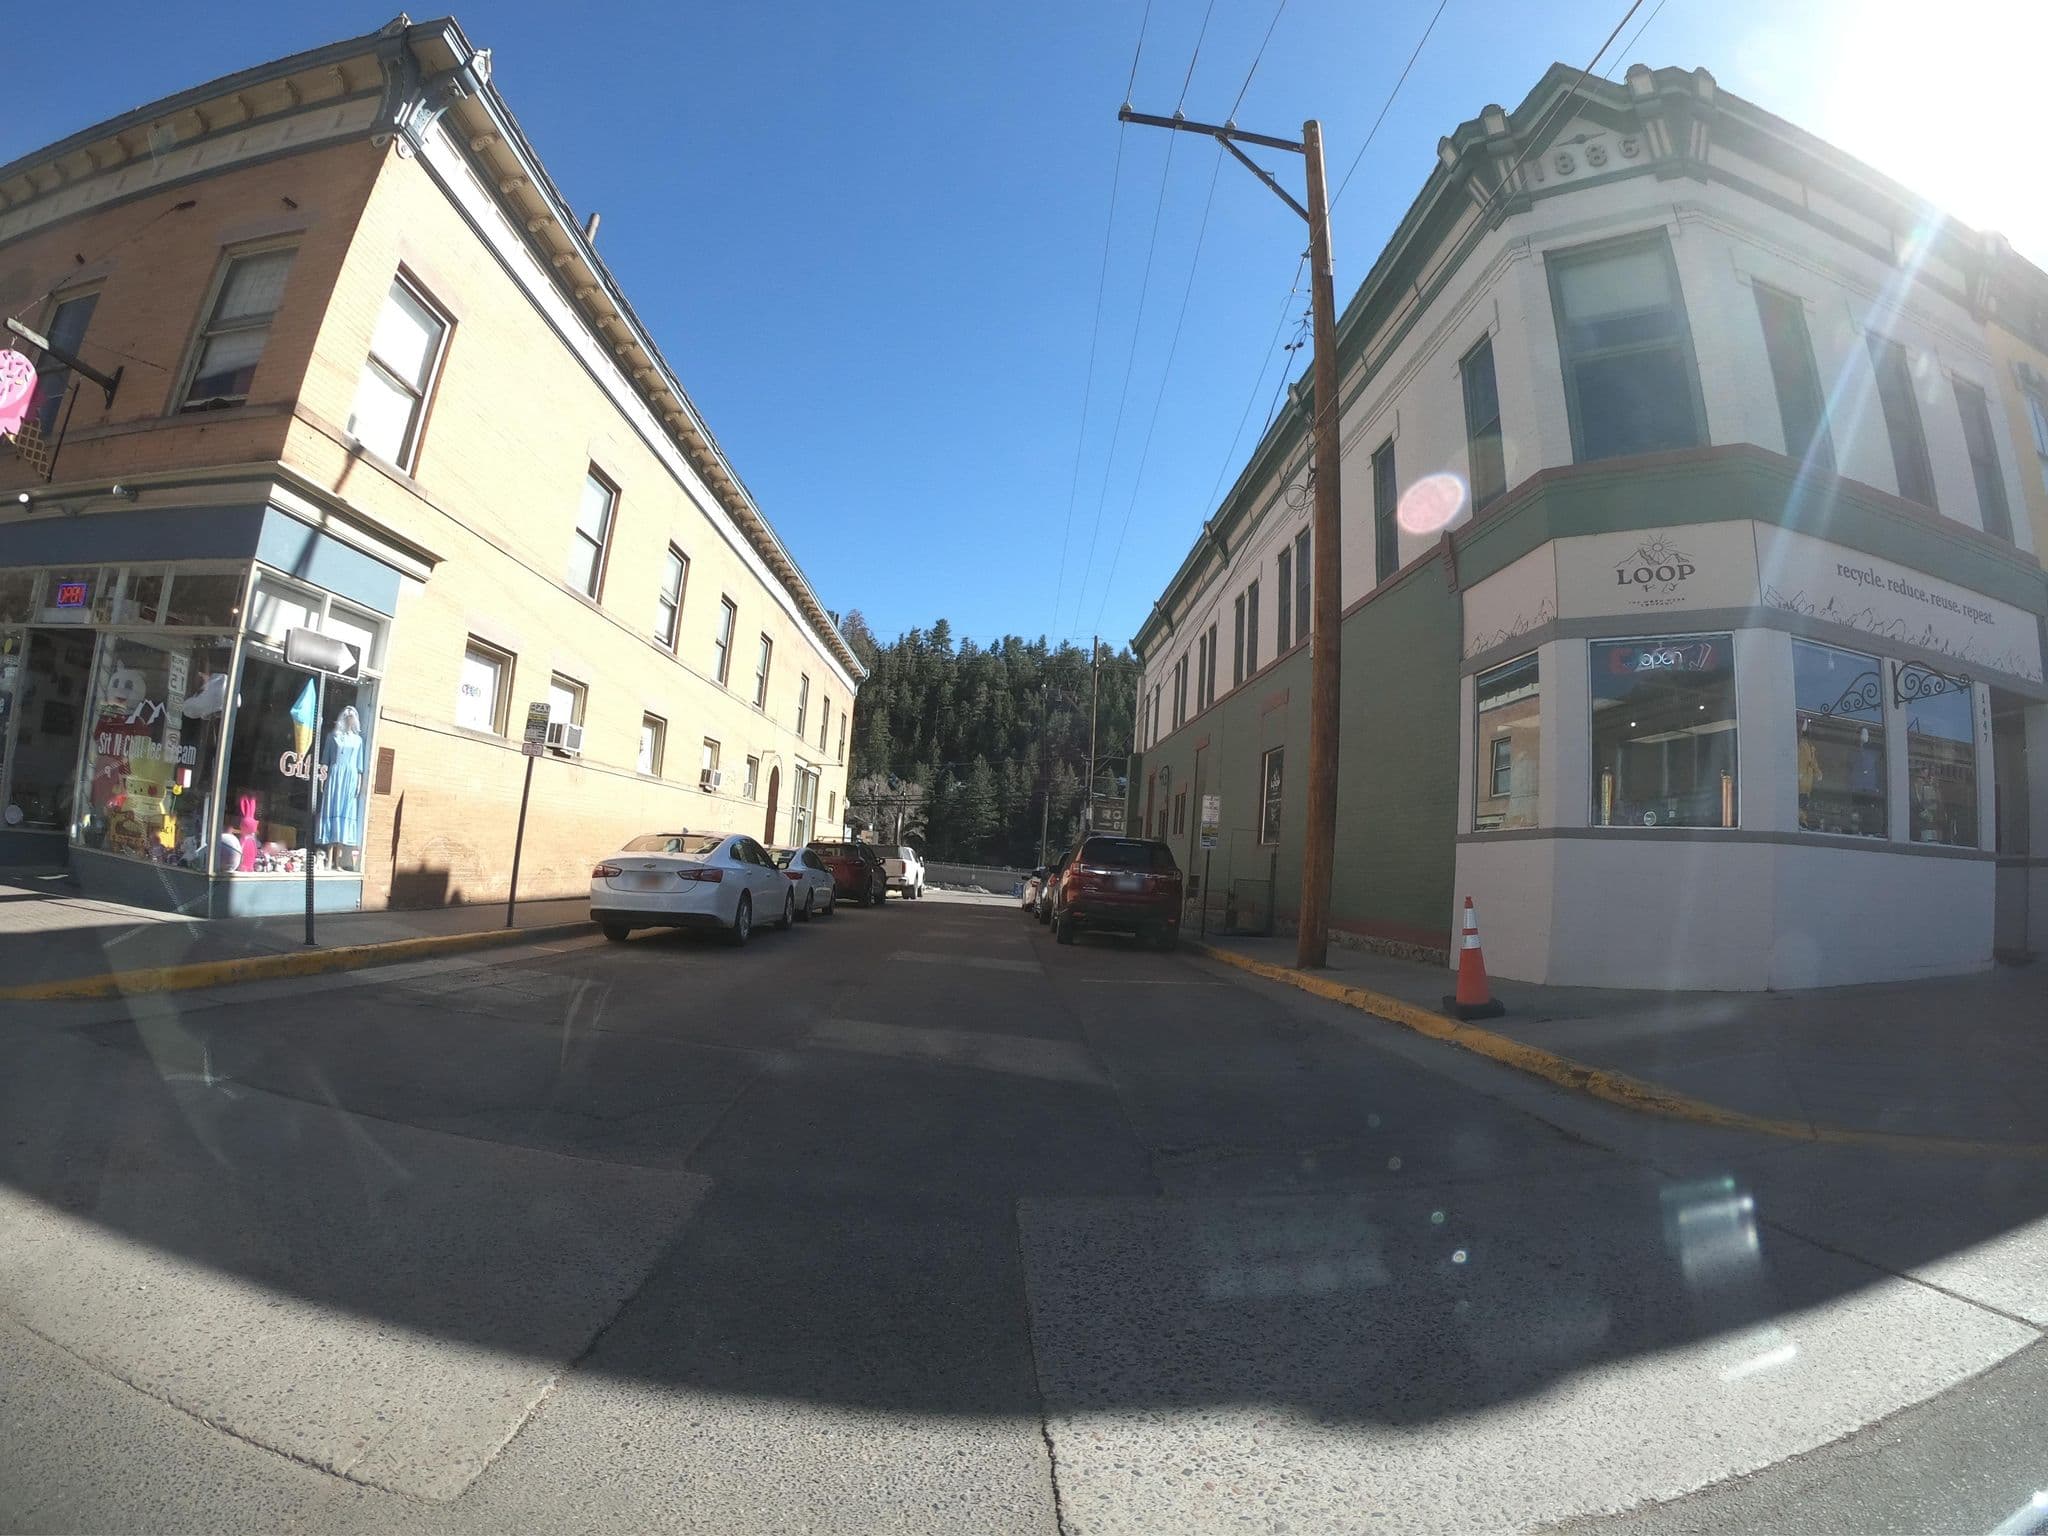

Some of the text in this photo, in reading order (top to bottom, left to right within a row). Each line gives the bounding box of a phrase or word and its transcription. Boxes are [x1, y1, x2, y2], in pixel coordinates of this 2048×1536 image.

[1616, 564, 1696, 585] LOOP
[61, 586, 84, 604] OPEN
[1640, 651, 1683, 669] open
[98, 731, 113, 755] Sit
[113, 733, 123, 757] N
[279, 750, 329, 781] Gifs
